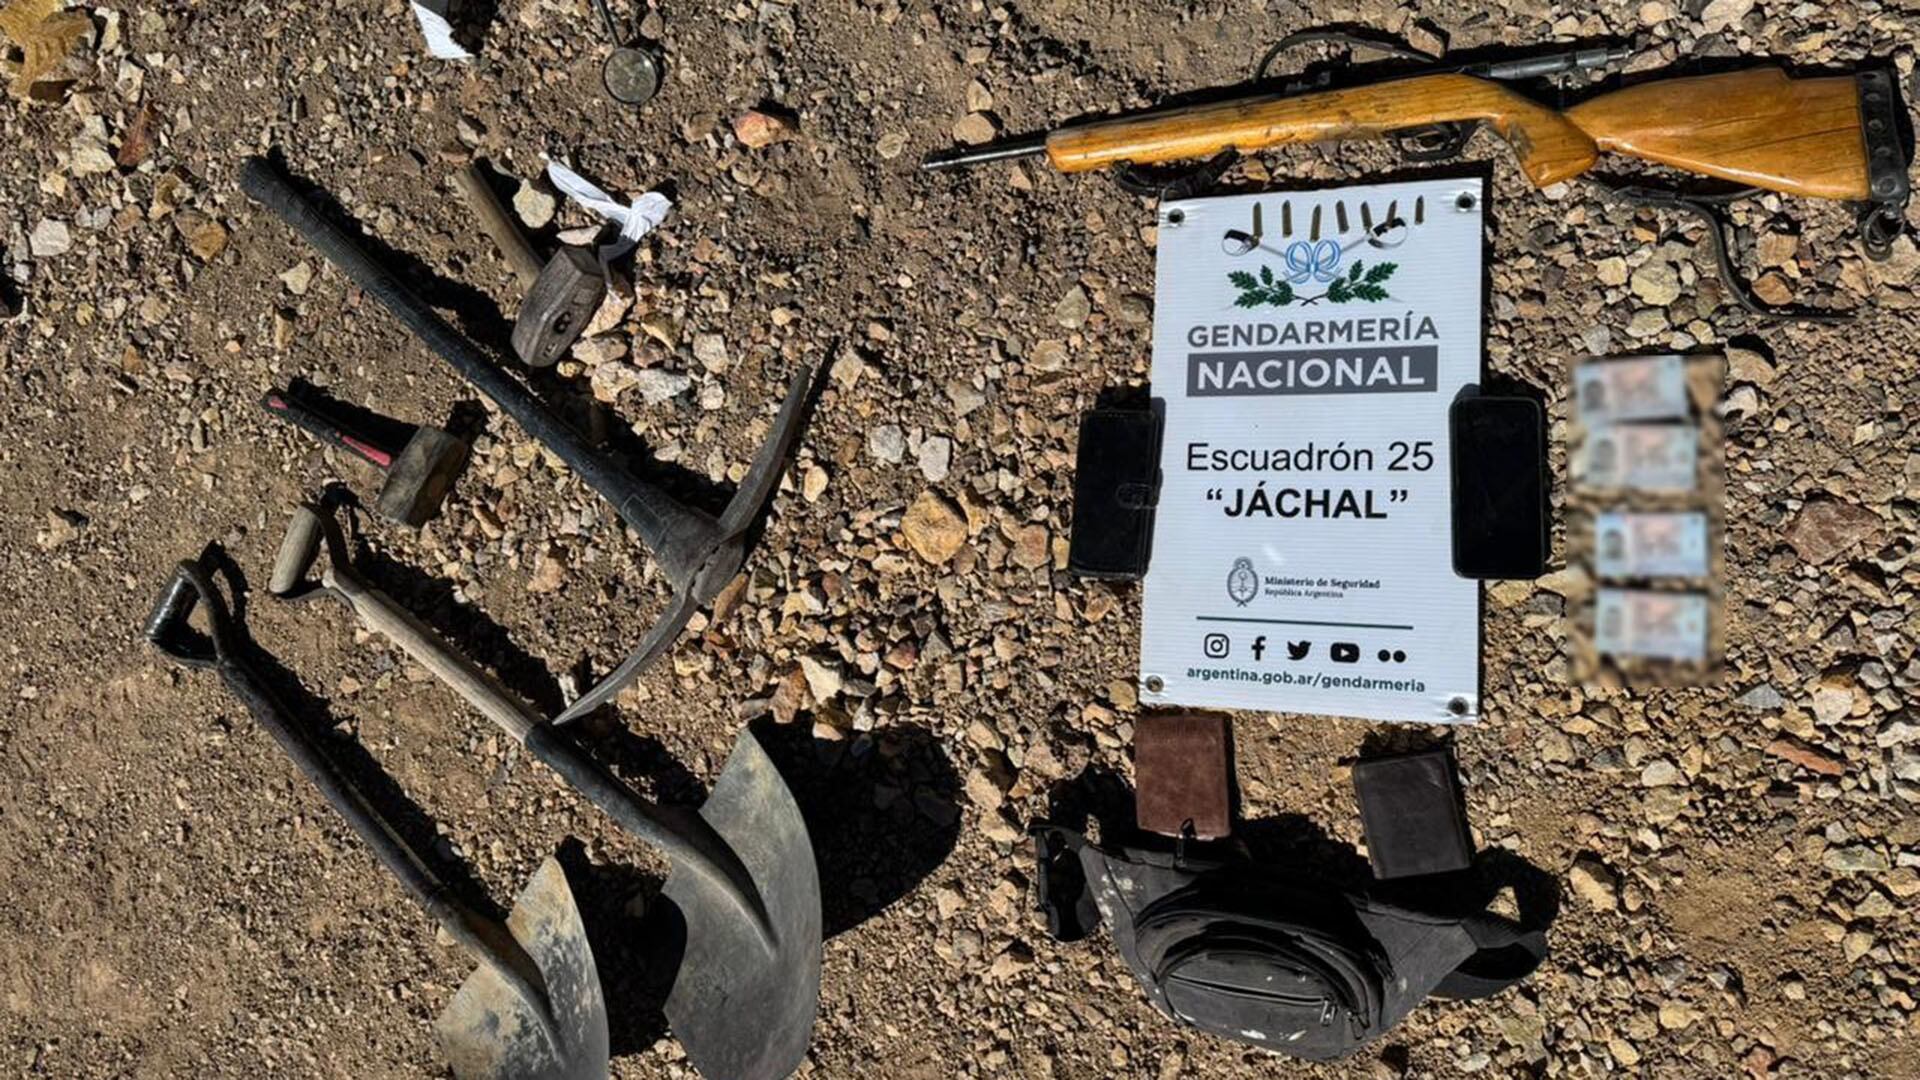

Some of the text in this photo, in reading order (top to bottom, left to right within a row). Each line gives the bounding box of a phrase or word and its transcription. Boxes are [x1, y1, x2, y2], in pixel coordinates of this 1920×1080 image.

[1187, 310, 1439, 348] GENDARMERÍA
[1197, 355, 1425, 390] NACIONAL
[1187, 441, 1434, 471] Escuadrón 25
[1264, 576, 1381, 590] Ministerio de Seguridad
[1264, 588, 1344, 599] República Argentina
[1186, 666, 1426, 693] argentina.gob.ar/gendarmeria
